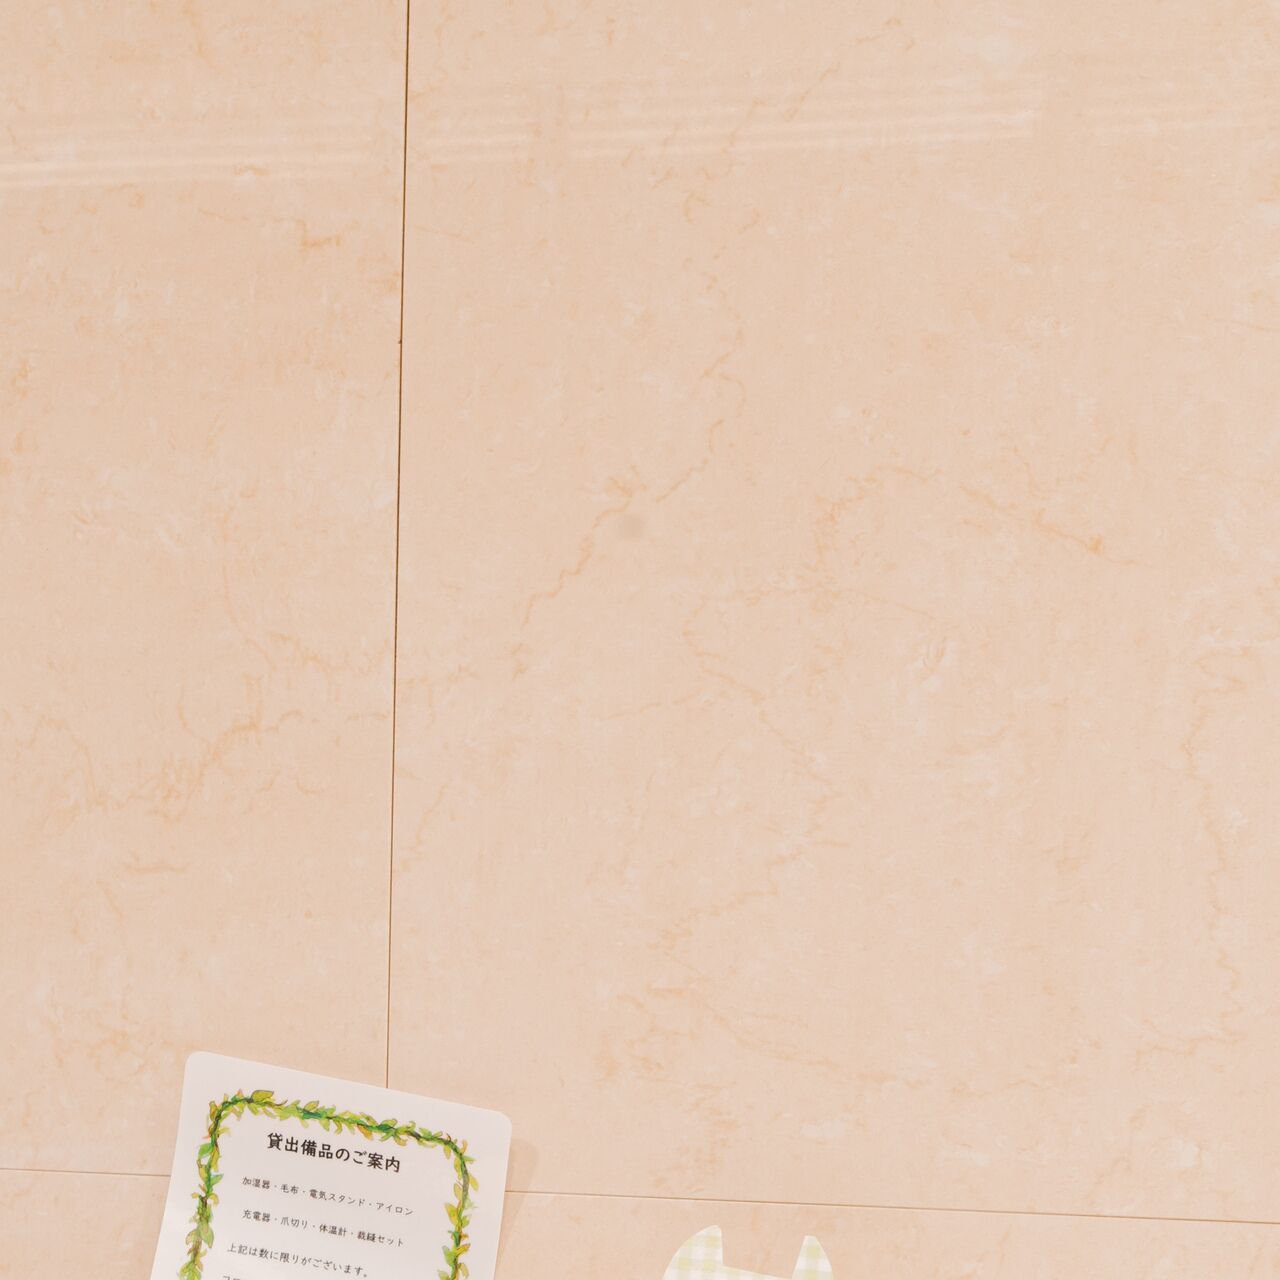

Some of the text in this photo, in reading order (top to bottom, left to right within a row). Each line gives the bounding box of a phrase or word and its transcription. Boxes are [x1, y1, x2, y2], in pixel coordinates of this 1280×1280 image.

[266, 1131, 401, 1173] 貸出備品のご案内
[227, 1241, 369, 1279] 上記は数に限りがございます。
